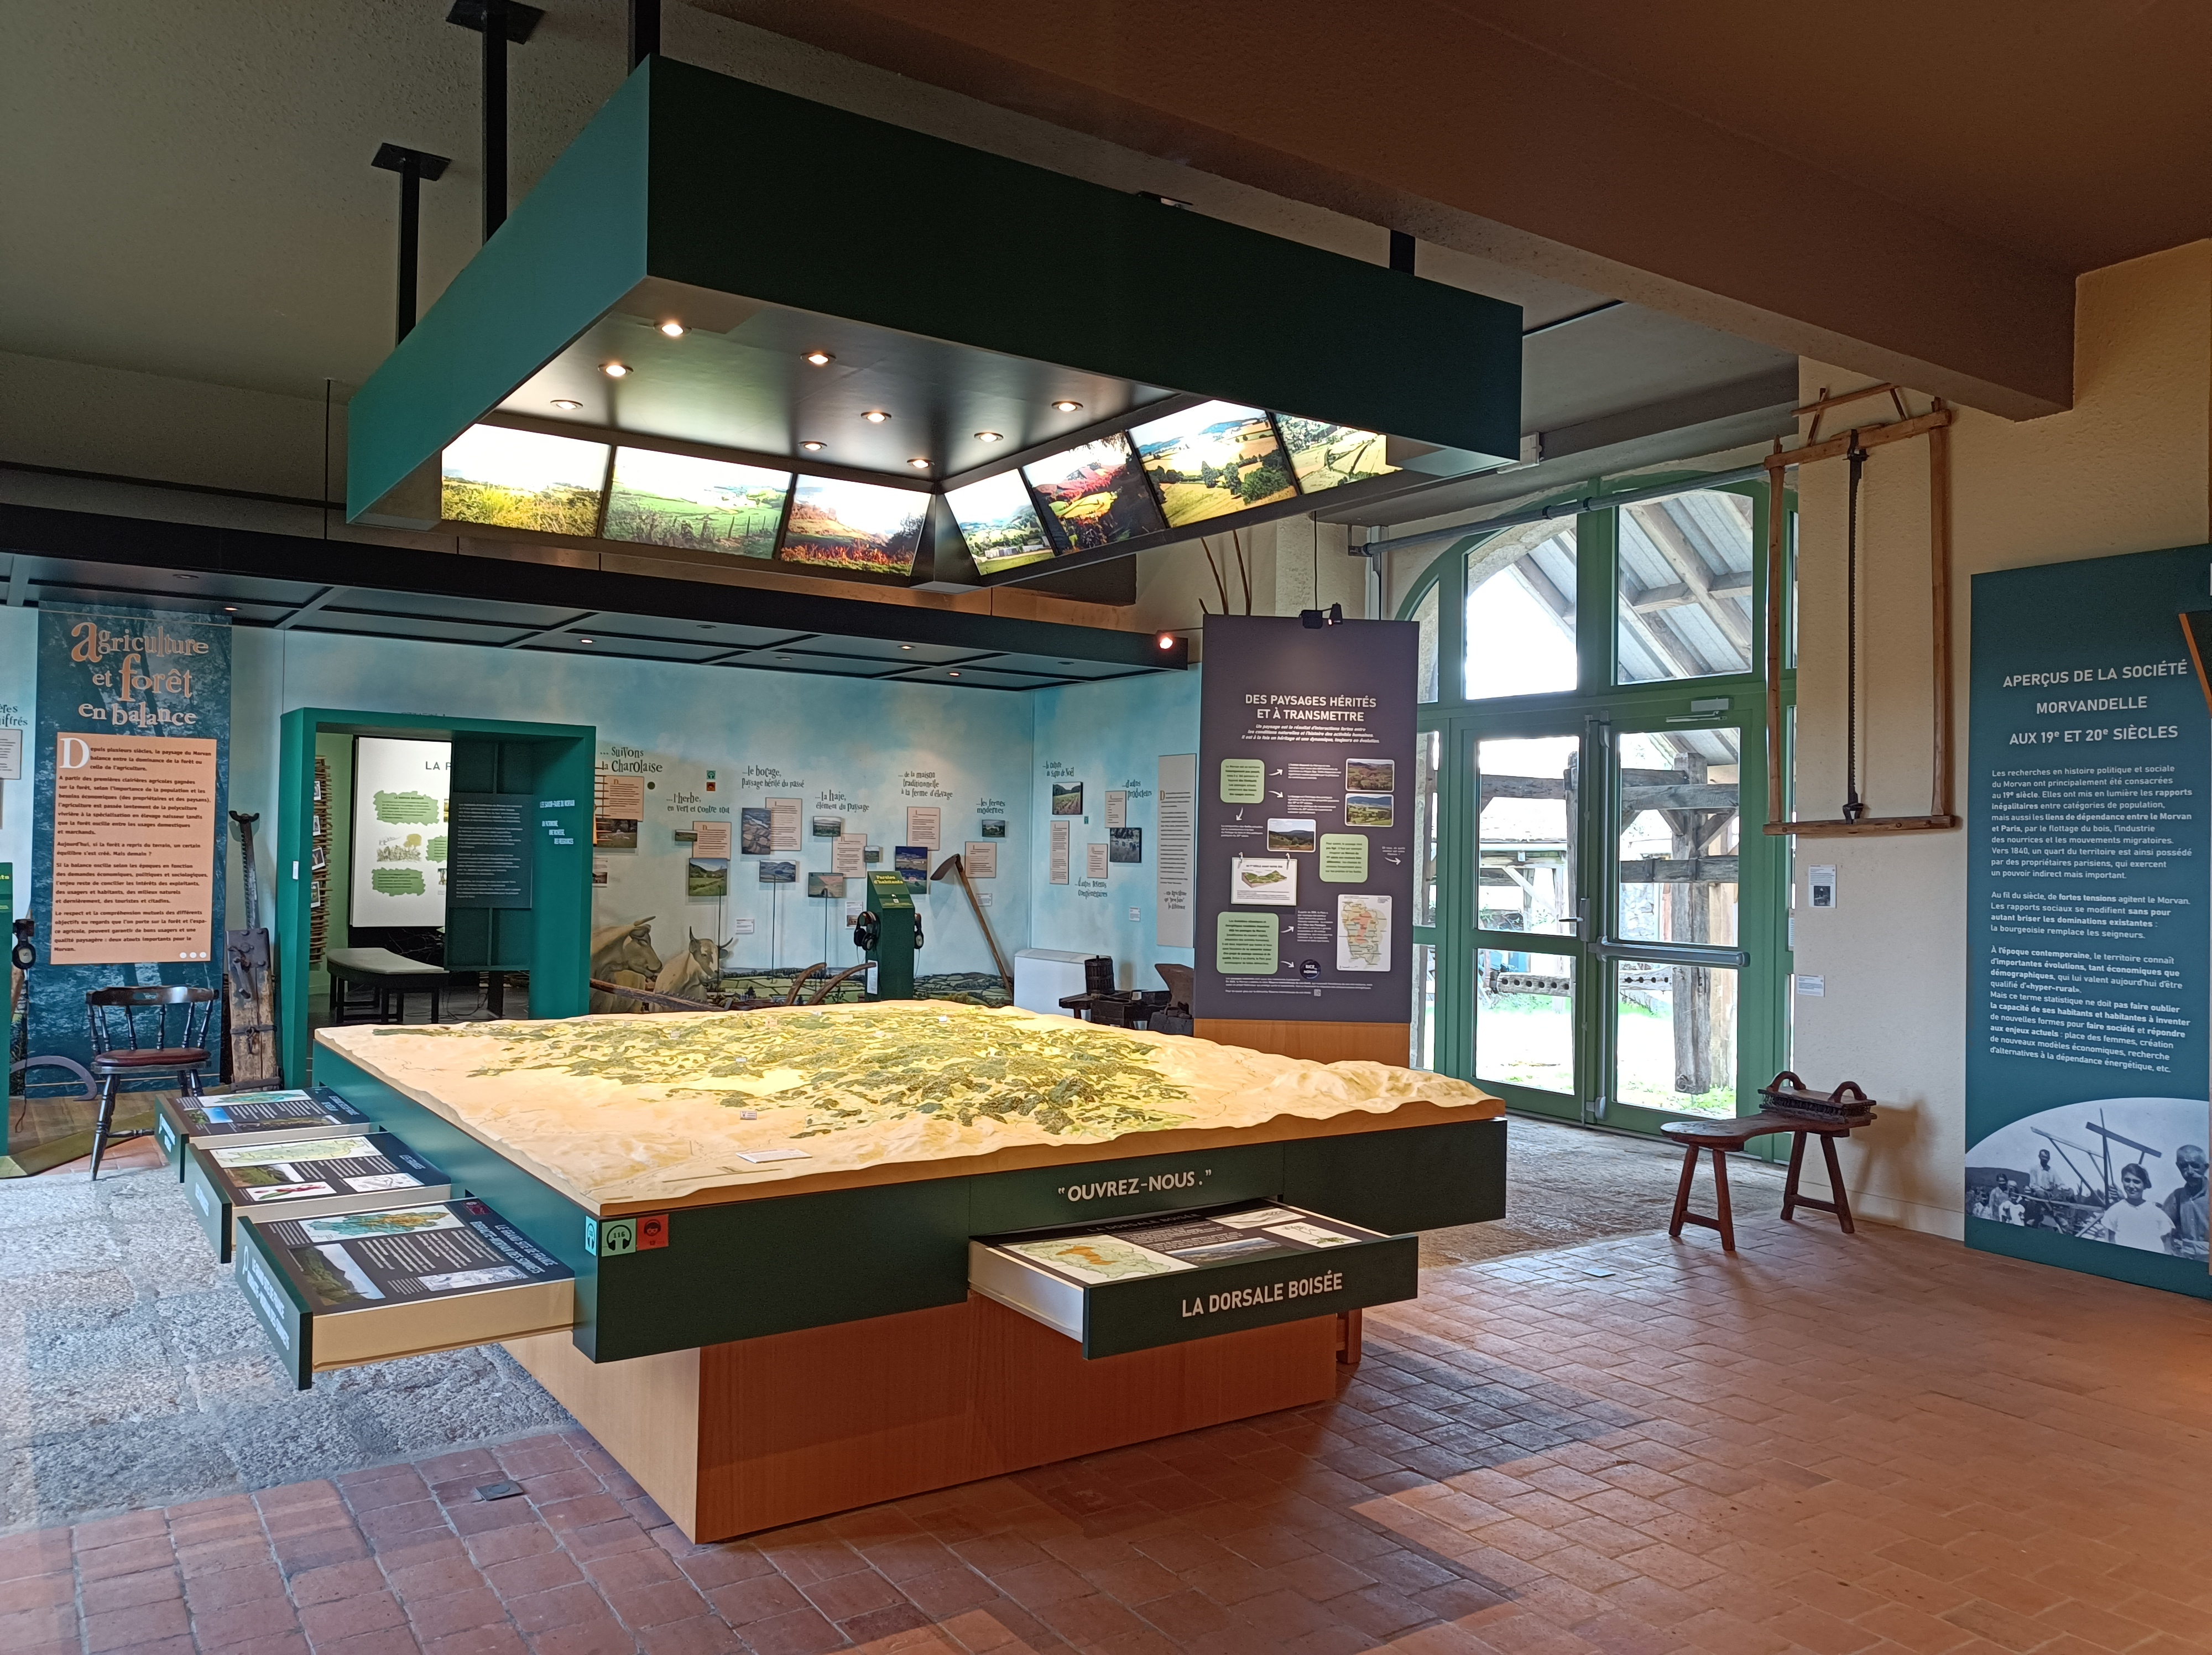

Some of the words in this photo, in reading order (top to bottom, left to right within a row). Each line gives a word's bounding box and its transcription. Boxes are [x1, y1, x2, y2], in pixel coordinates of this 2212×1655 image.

[71, 622, 210, 663] agriculture
[92, 670, 113, 688] et
[118, 653, 193, 702] forêt
[2002, 671, 2069, 688] APERÇUS
[2074, 669, 2093, 682] DE
[2098, 667, 2117, 680] LA
[2121, 658, 2188, 679] SOCIÉTÉ
[1245, 694, 1267, 704] DES
[1270, 695, 1326, 706] PAYSAGES
[1329, 695, 1376, 707] HÉRITÉS
[2036, 695, 2147, 714] MORVANDELLE
[78, 702, 107, 721] en
[111, 701, 197, 729] balance
[1257, 709, 1271, 719] ET
[1272, 707, 1281, 719] À
[1283, 709, 1364, 722] TRANSMETTRE
[2008, 732, 2037, 745] AUX
[2041, 731, 2059, 743] 19e
[2064, 730, 2082, 742] ET
[2085, 728, 2109, 741] 20e
[2112, 724, 2178, 740] SIÈCLES
[611, 746, 644, 758] Suivons
[425, 761, 441, 771] LA
[611, 759, 663, 773] Charolaise
[2096, 766, 2132, 776] politique
[2145, 764, 2175, 773] sociale
[764, 778, 781, 788] hérité
[781, 779, 789, 788] du
[790, 779, 805, 788] passé
[902, 778, 940, 789] traditionnelle
[2047, 778, 2107, 788] principalement
[2109, 777, 2122, 785] été
[2124, 776, 2173, 785] consacrées
[829, 789, 847, 802] haie,
[911, 788, 928, 798] ferme
[930, 789, 953, 800] d'élevage
[2106, 788, 2138, 797] lumière
[2154, 788, 2192, 798] rapports
[816, 802, 837, 810] élément
[977, 806, 1004, 815] modernes
[1991, 802, 2038, 811] inégalitaires
[2063, 800, 2105, 810] catégories
[2119, 800, 2166, 810] population,
[2076, 812, 2125, 822] dépendance
[1182, 1297, 1204, 1318] LA
[1209, 1282, 1284, 1313] DORSALE
[1288, 1269, 1343, 1299] BOISÉE
